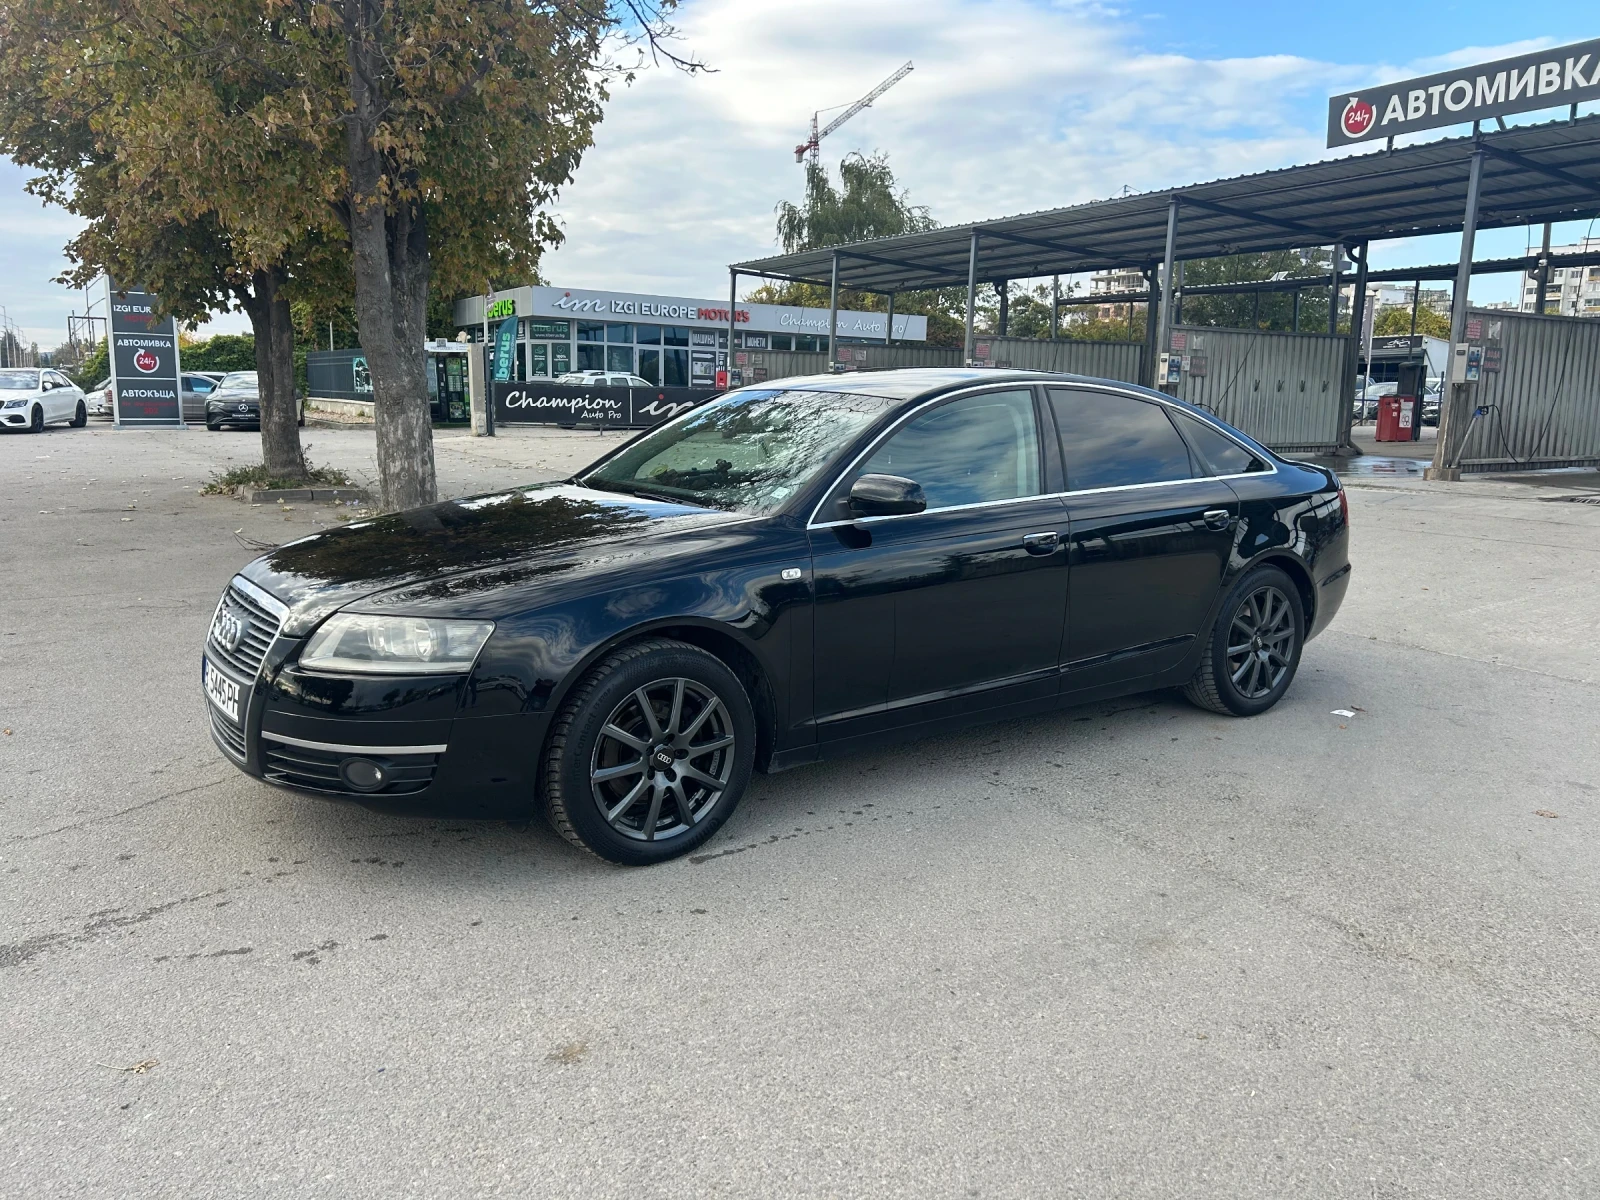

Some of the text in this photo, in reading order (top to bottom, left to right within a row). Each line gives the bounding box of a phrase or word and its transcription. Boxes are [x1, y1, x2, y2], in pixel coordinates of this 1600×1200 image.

[1348, 109, 1370, 126] 24/7
[113, 304, 152, 314] IZGI EUR
[486, 298, 514, 319] berus
[610, 299, 638, 315] IZGI
[640, 302, 696, 320] EUROPE
[532, 322, 569, 332] tiberus
[780, 312, 848, 331] Champin
[853, 318, 881, 333] Auto
[117, 338, 172, 348] АВТОМИВКА
[692, 333, 715, 345] МАШИНА
[746, 336, 766, 348] МОНЕТИ
[139, 356, 155, 368] 24/7
[495, 332, 511, 383] iberus
[121, 389, 176, 399] АВТОКЪЩА
[505, 390, 622, 413] Champion
[581, 410, 622, 420] Auto Pro
